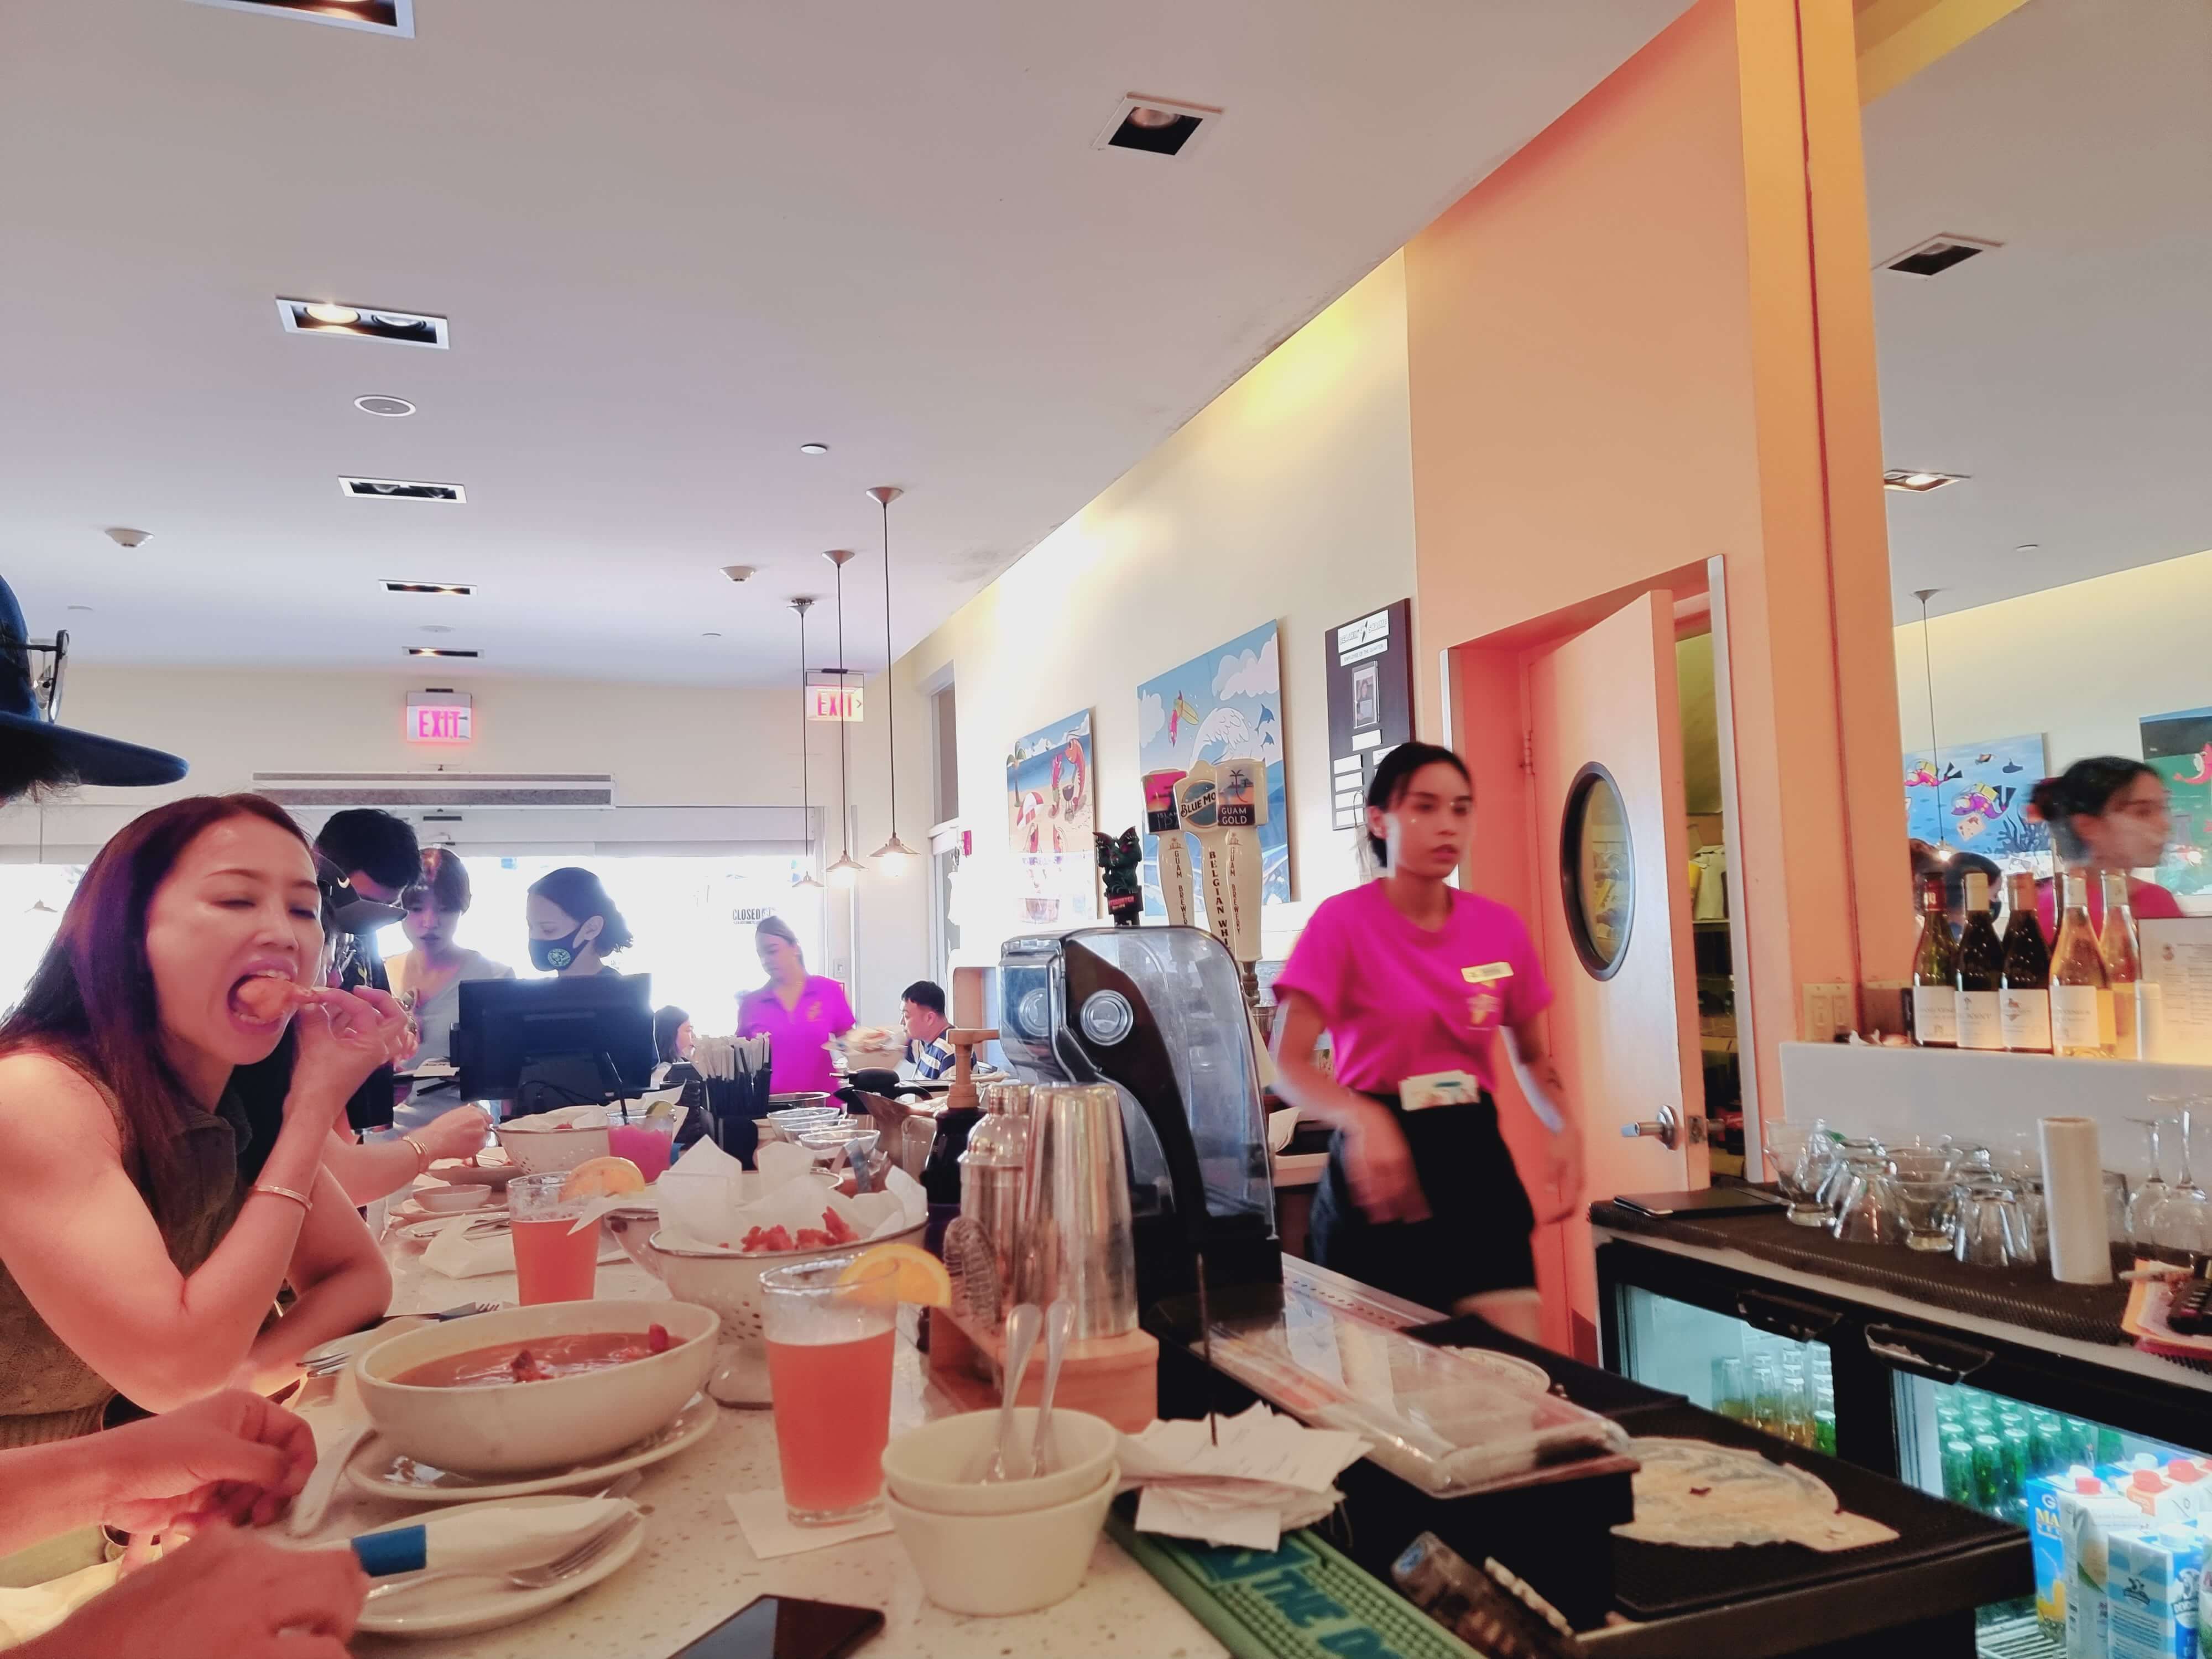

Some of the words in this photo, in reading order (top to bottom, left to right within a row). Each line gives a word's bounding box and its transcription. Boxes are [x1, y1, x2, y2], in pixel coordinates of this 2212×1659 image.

[817, 690, 852, 717] EXIT
[419, 710, 460, 738] EXIT
[1180, 800, 1202, 818] BLUE
[1203, 791, 1217, 806] MO
[1221, 807, 1246, 815] GUAM
[1222, 815, 1248, 825] GOLD
[1174, 851, 1182, 878] GUAM
[1209, 851, 1225, 914] BELGIAN
[1218, 919, 1231, 950] WHI
[1232, 884, 1241, 935] BREWERY
[732, 908, 761, 921] CLOSED
